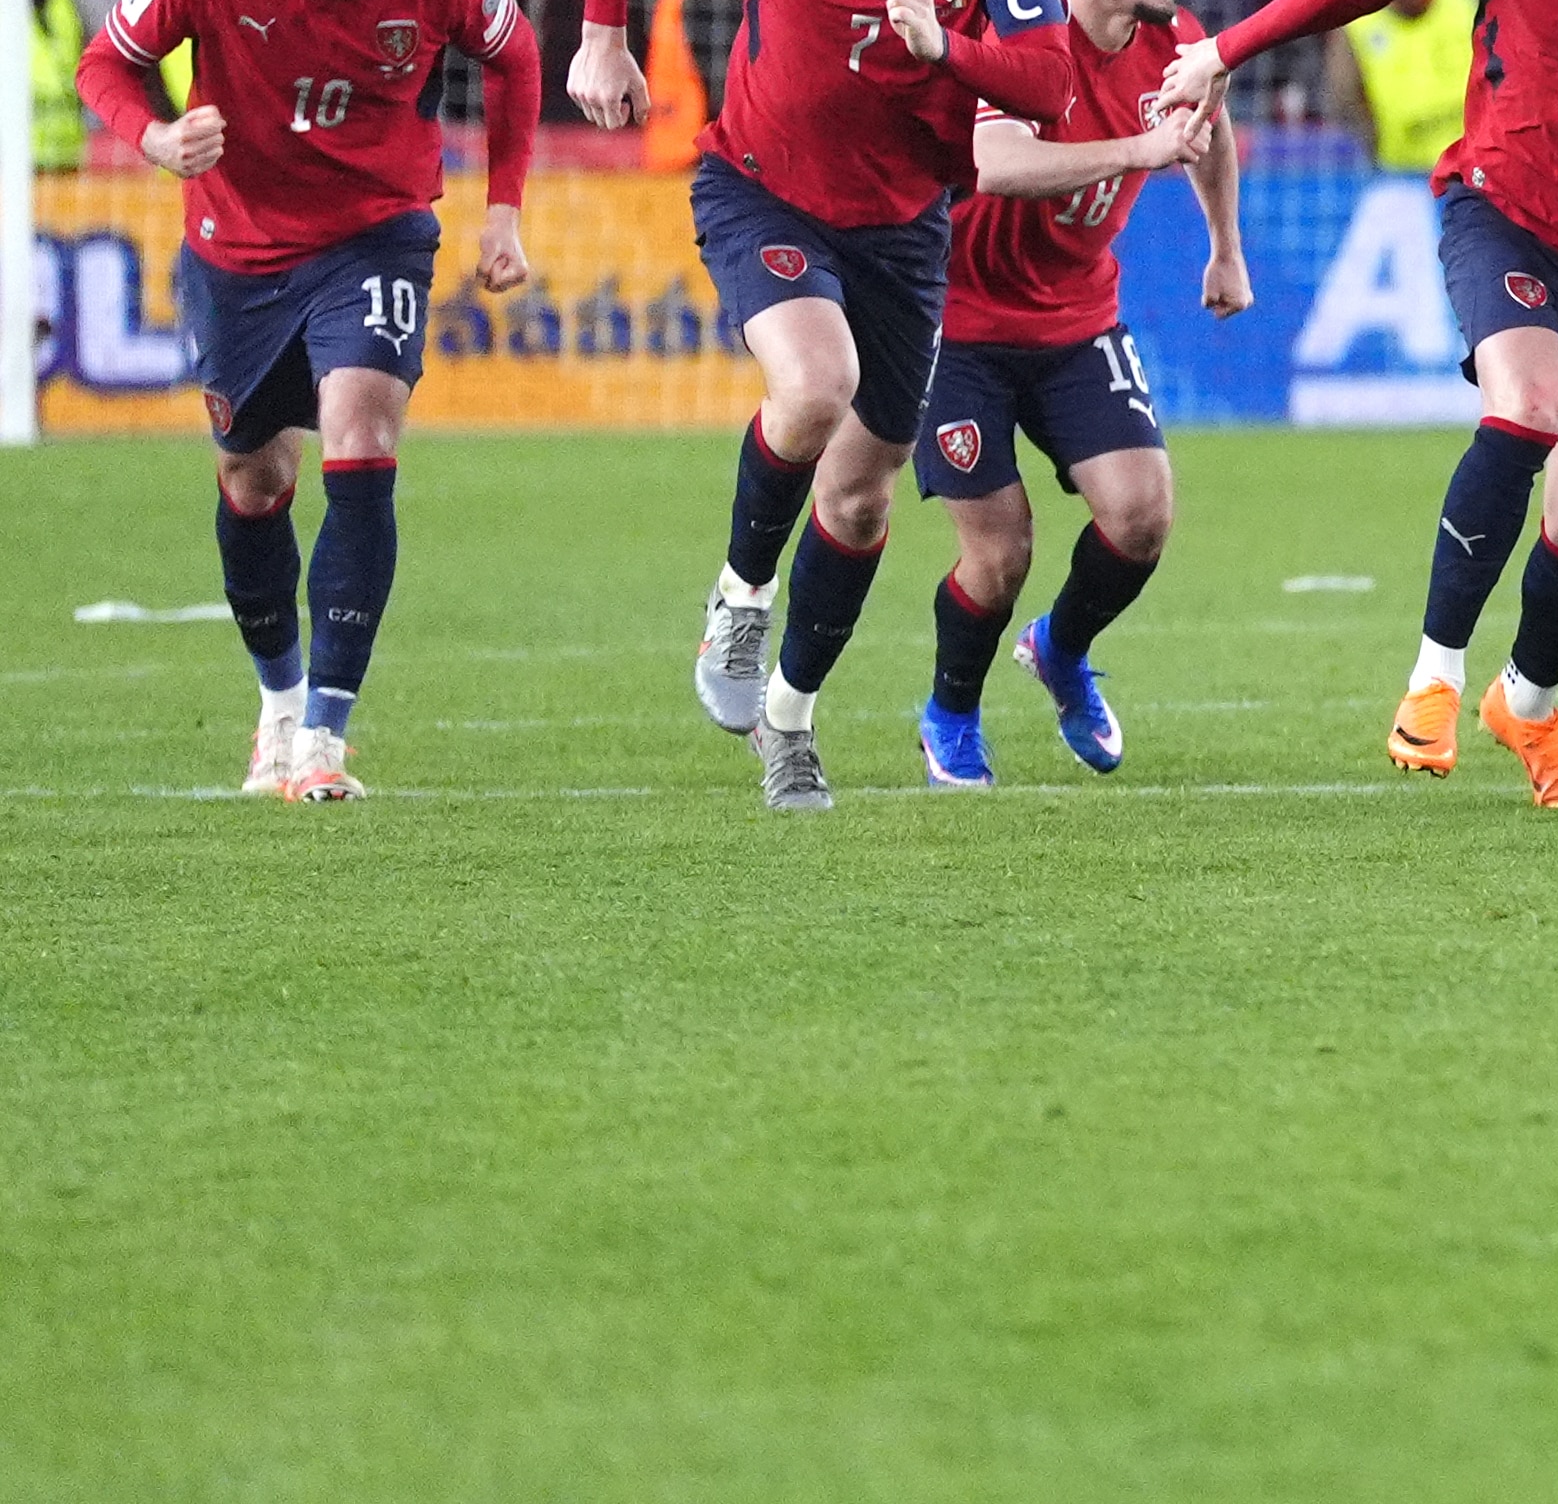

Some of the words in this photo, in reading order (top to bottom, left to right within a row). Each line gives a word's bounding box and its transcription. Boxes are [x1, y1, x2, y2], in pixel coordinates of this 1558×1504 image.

[849, 13, 881, 72] 7
[289, 76, 353, 133] 10
[360, 274, 418, 334] 10
[1094, 333, 1150, 394] 18
